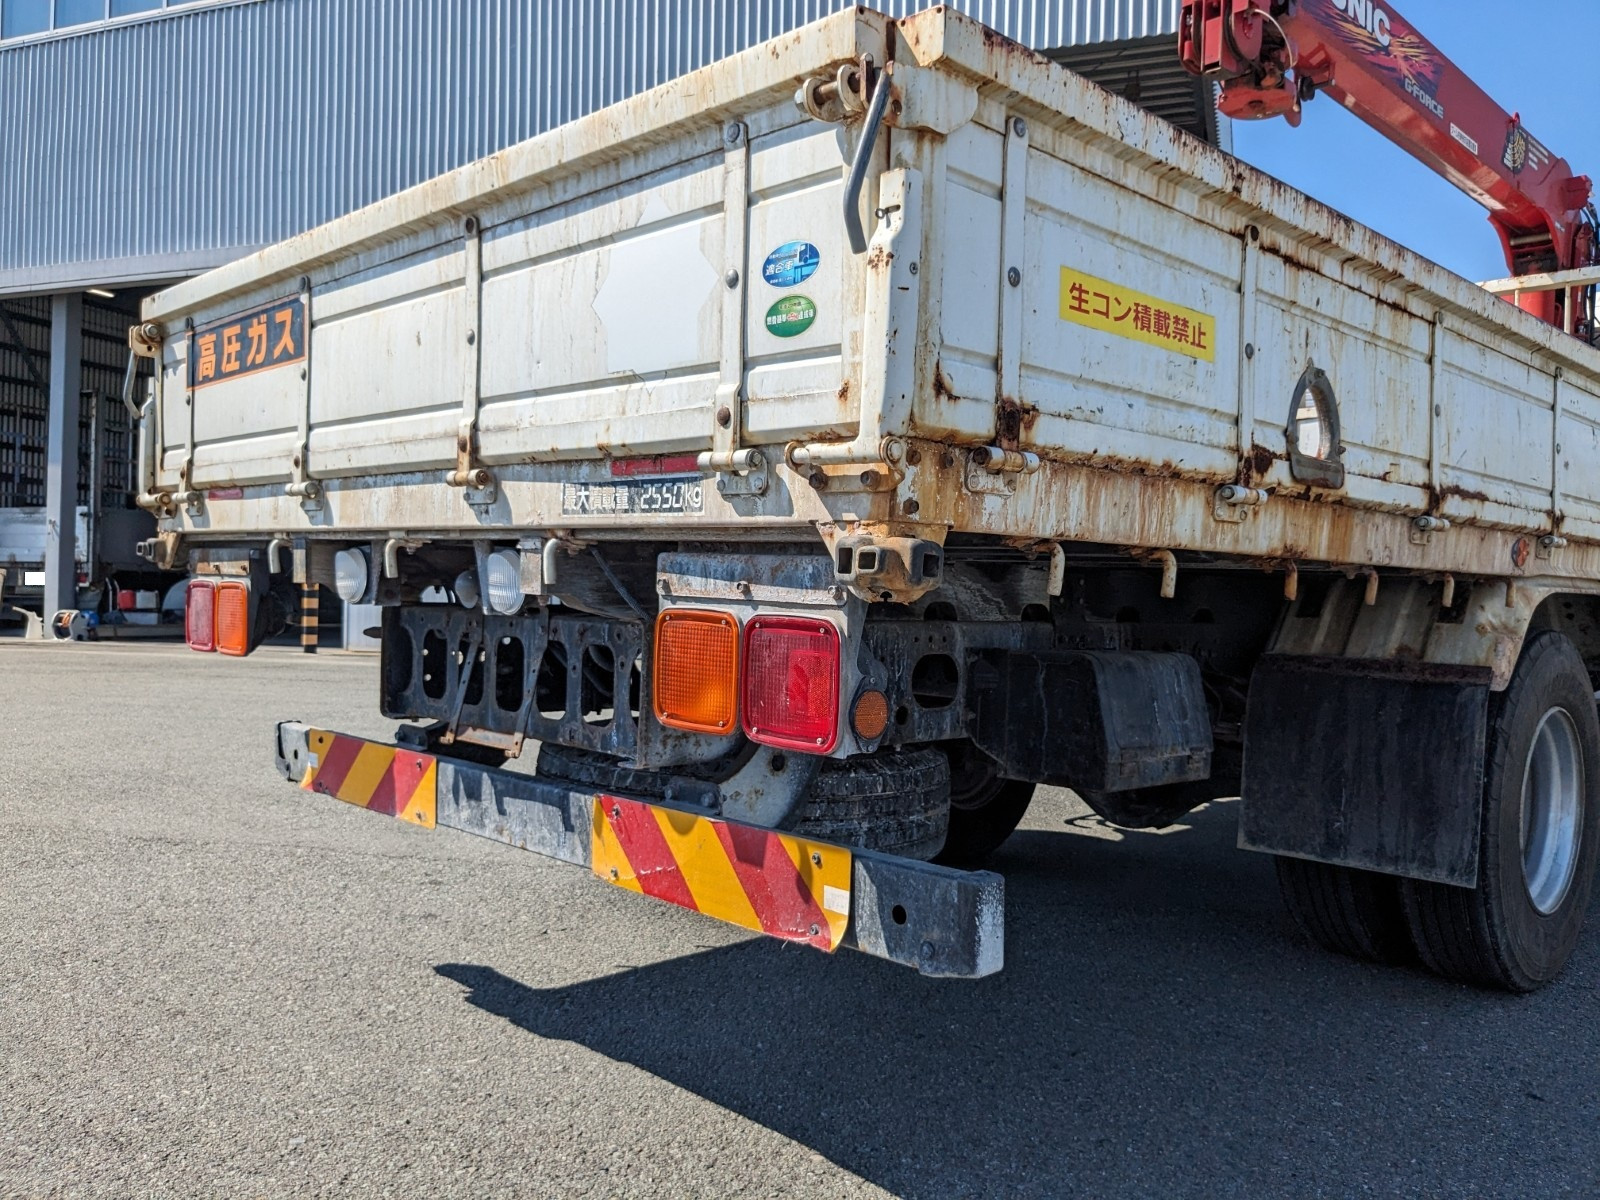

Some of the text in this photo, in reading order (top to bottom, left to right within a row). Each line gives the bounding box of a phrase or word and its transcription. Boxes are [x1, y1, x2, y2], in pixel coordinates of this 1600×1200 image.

[1404, 77, 1444, 119] G-FORCE
[1068, 282, 1207, 350] 生コン積載禁止
[197, 308, 295, 382] 高圧ガス
[563, 484, 629, 511] 最大積載量
